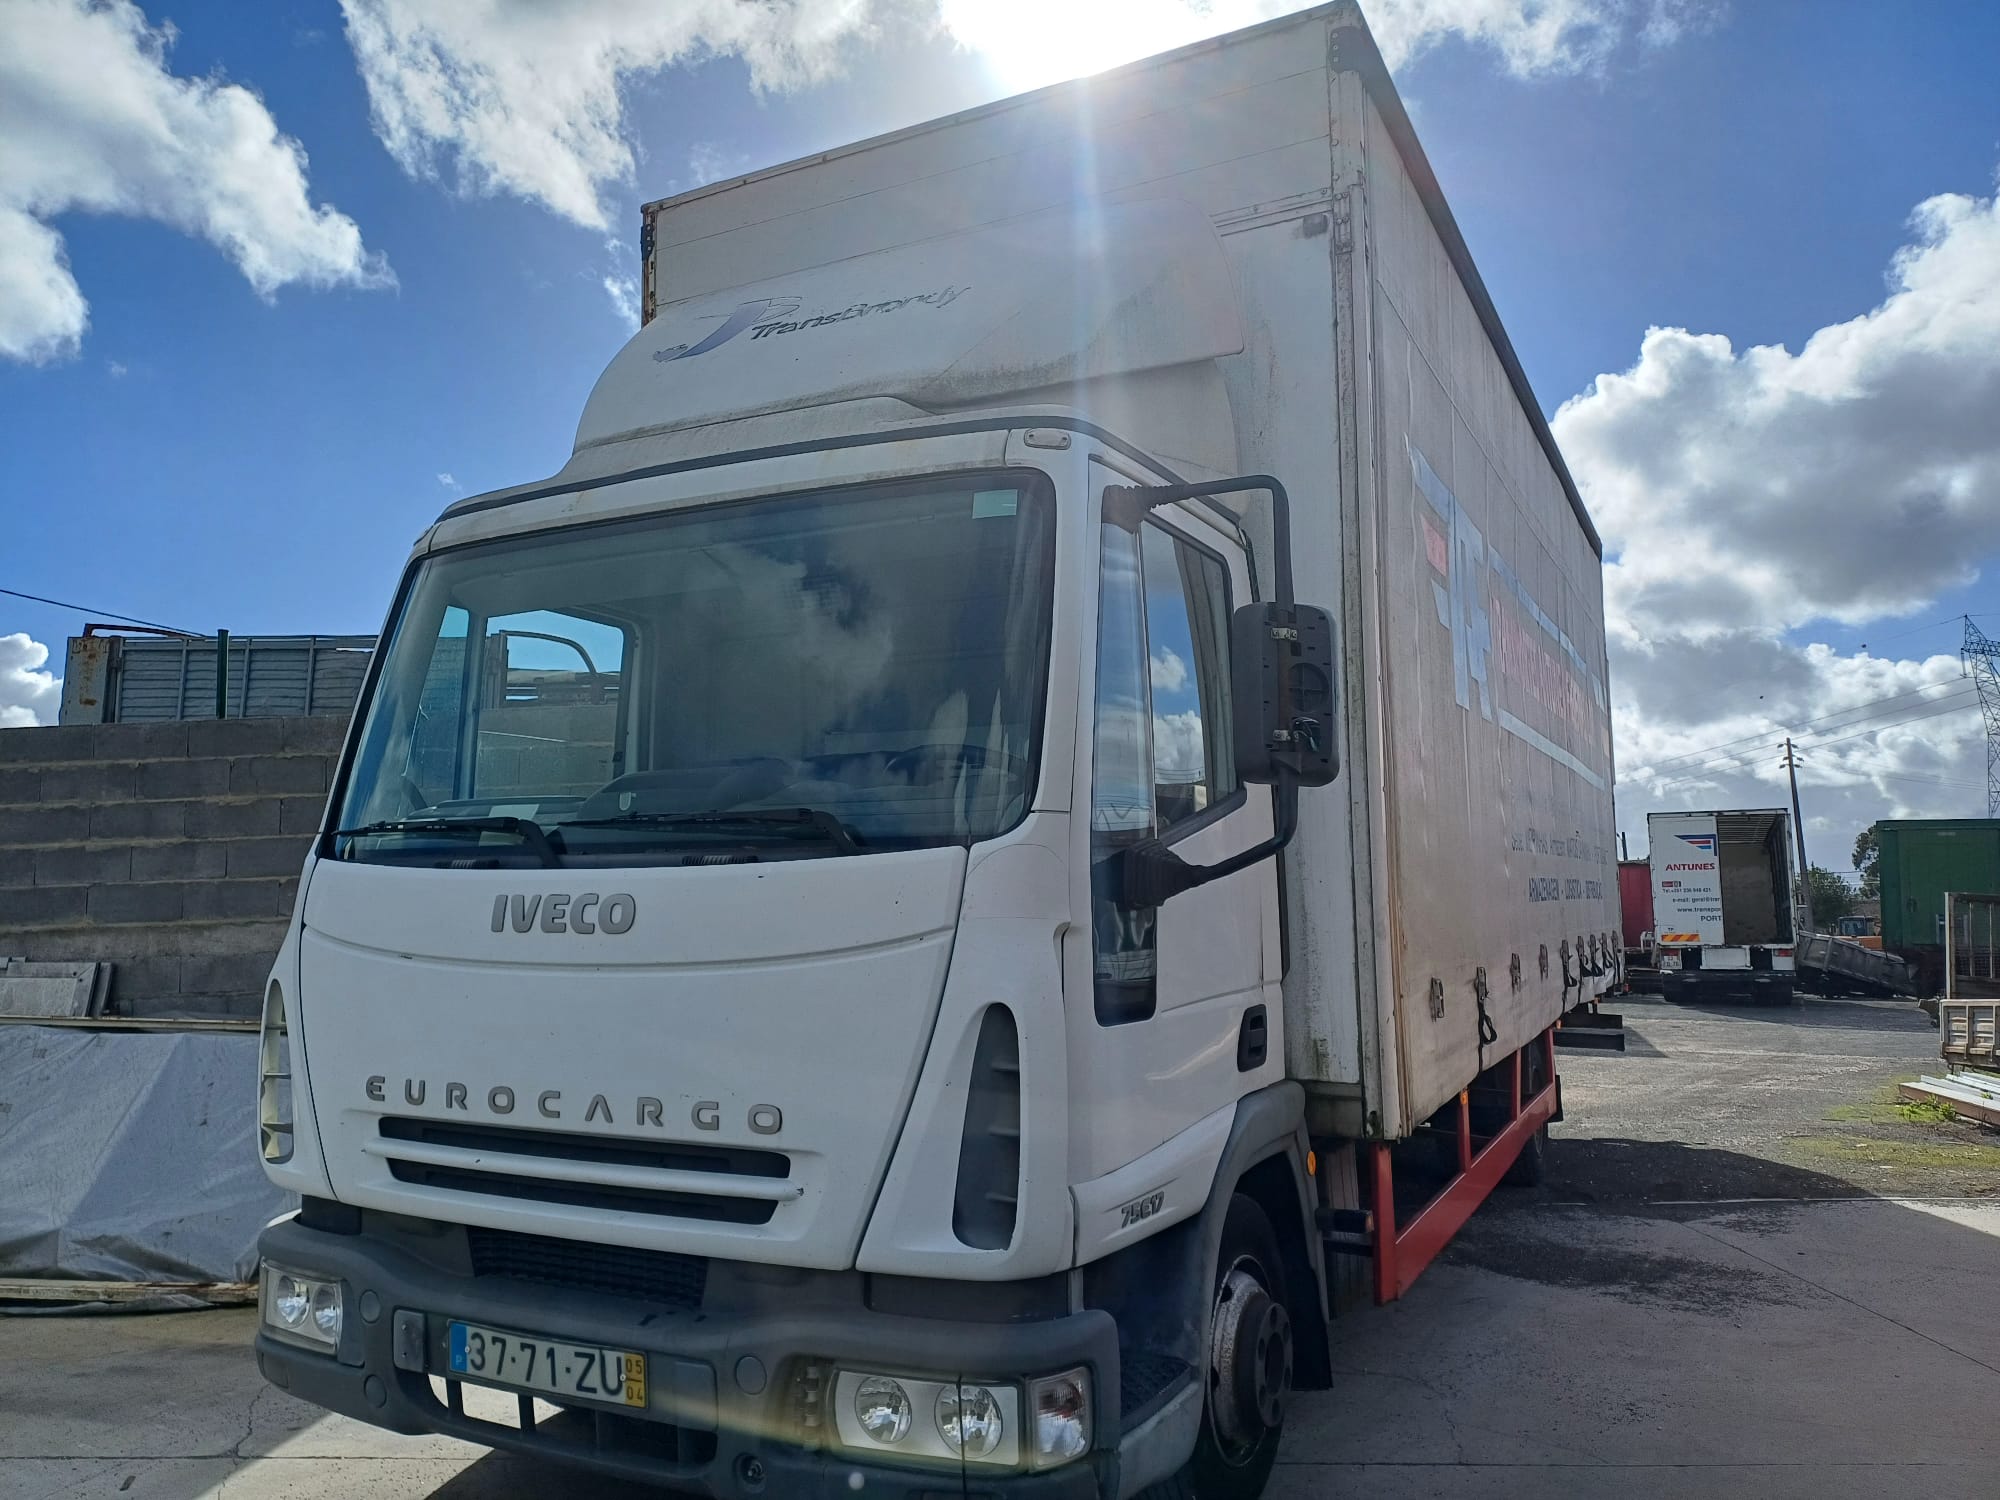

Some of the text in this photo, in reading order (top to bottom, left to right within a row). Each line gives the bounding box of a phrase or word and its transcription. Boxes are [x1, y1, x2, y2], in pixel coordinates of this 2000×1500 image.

[1666, 863, 1715, 871] ANTUNES
[490, 892, 636, 935] IVECO
[365, 1075, 784, 1135] EUROCARGO
[625, 1357, 643, 1375] 05
[625, 1385, 644, 1402] 04
